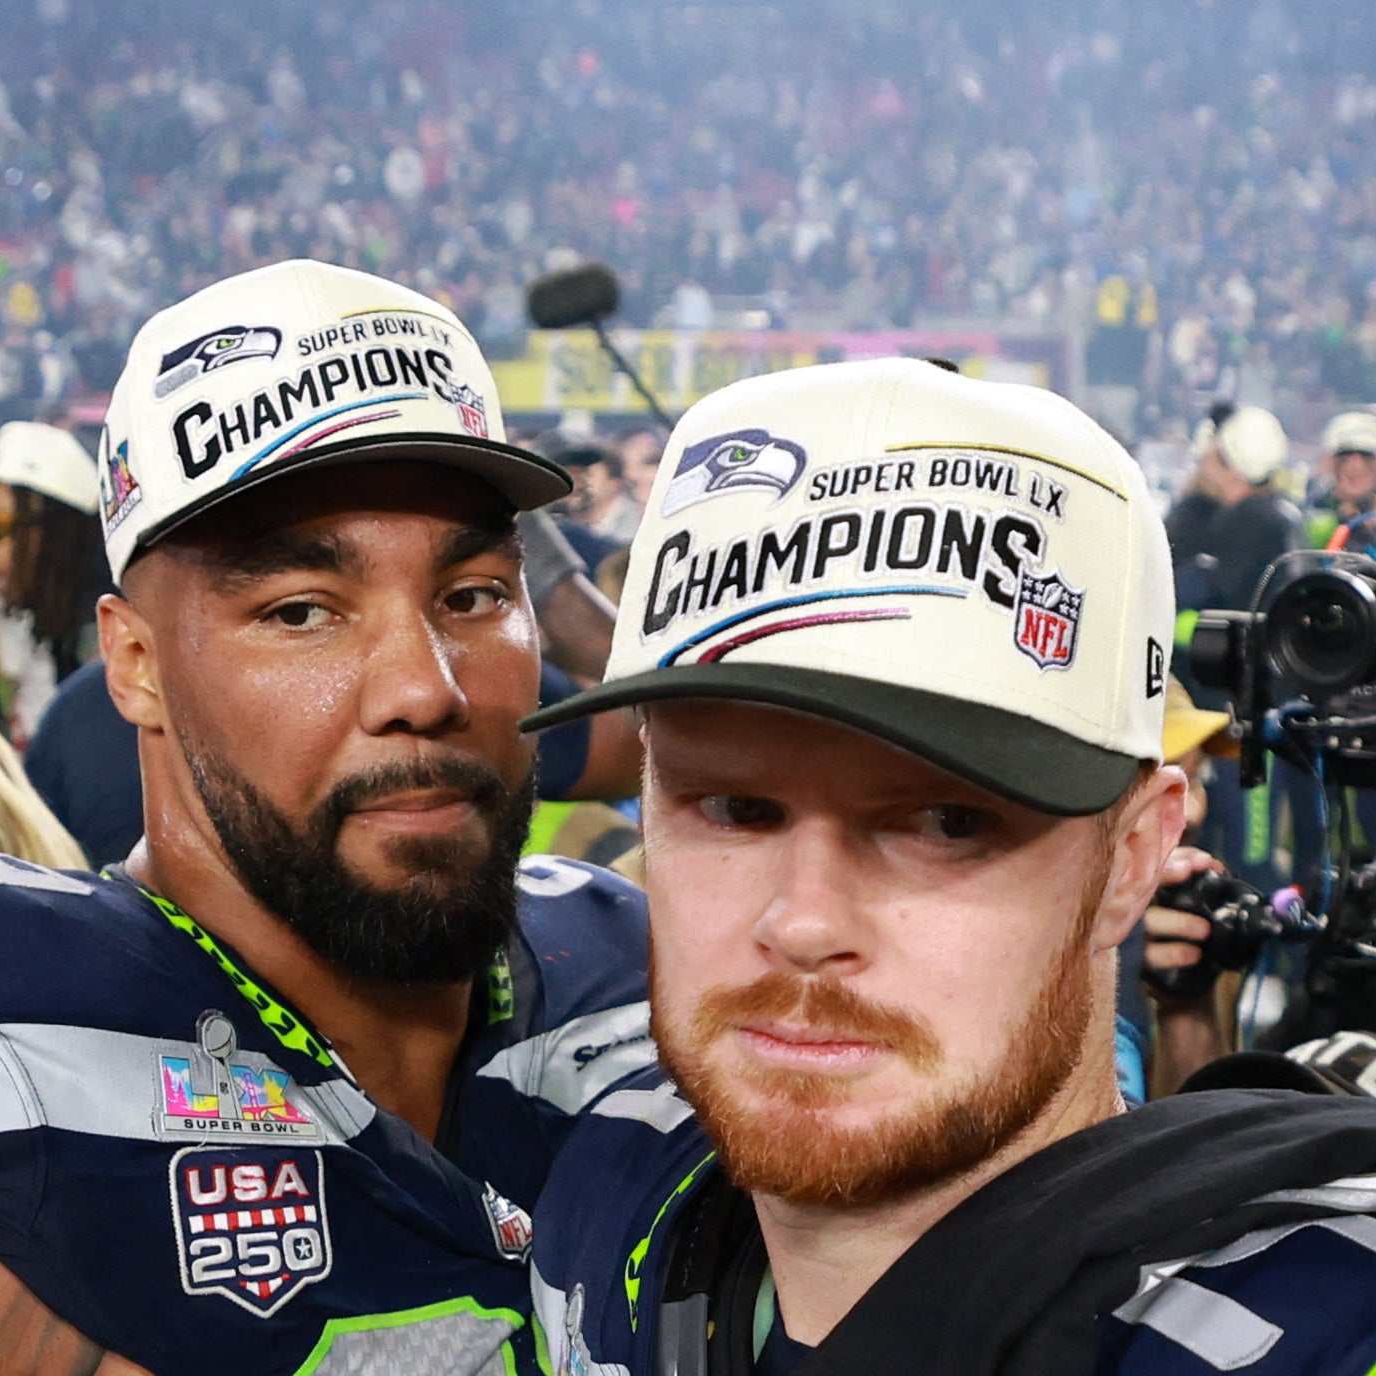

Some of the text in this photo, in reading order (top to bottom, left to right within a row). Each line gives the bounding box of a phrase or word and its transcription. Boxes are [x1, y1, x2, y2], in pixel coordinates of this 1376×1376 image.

[298, 318, 367, 356] SUPER
[373, 318, 426, 337] BOWL
[173, 347, 454, 479] CHAMPIONS
[459, 404, 488, 438] NFL
[809, 458, 1063, 517] SUPER BOWL LX
[641, 506, 1042, 638] CHAMPIONS
[1021, 610, 1068, 658] NFL
[183, 1118, 301, 1135] SUPER BOWL
[185, 1160, 309, 1206] USA
[189, 1227, 321, 1284] 250
